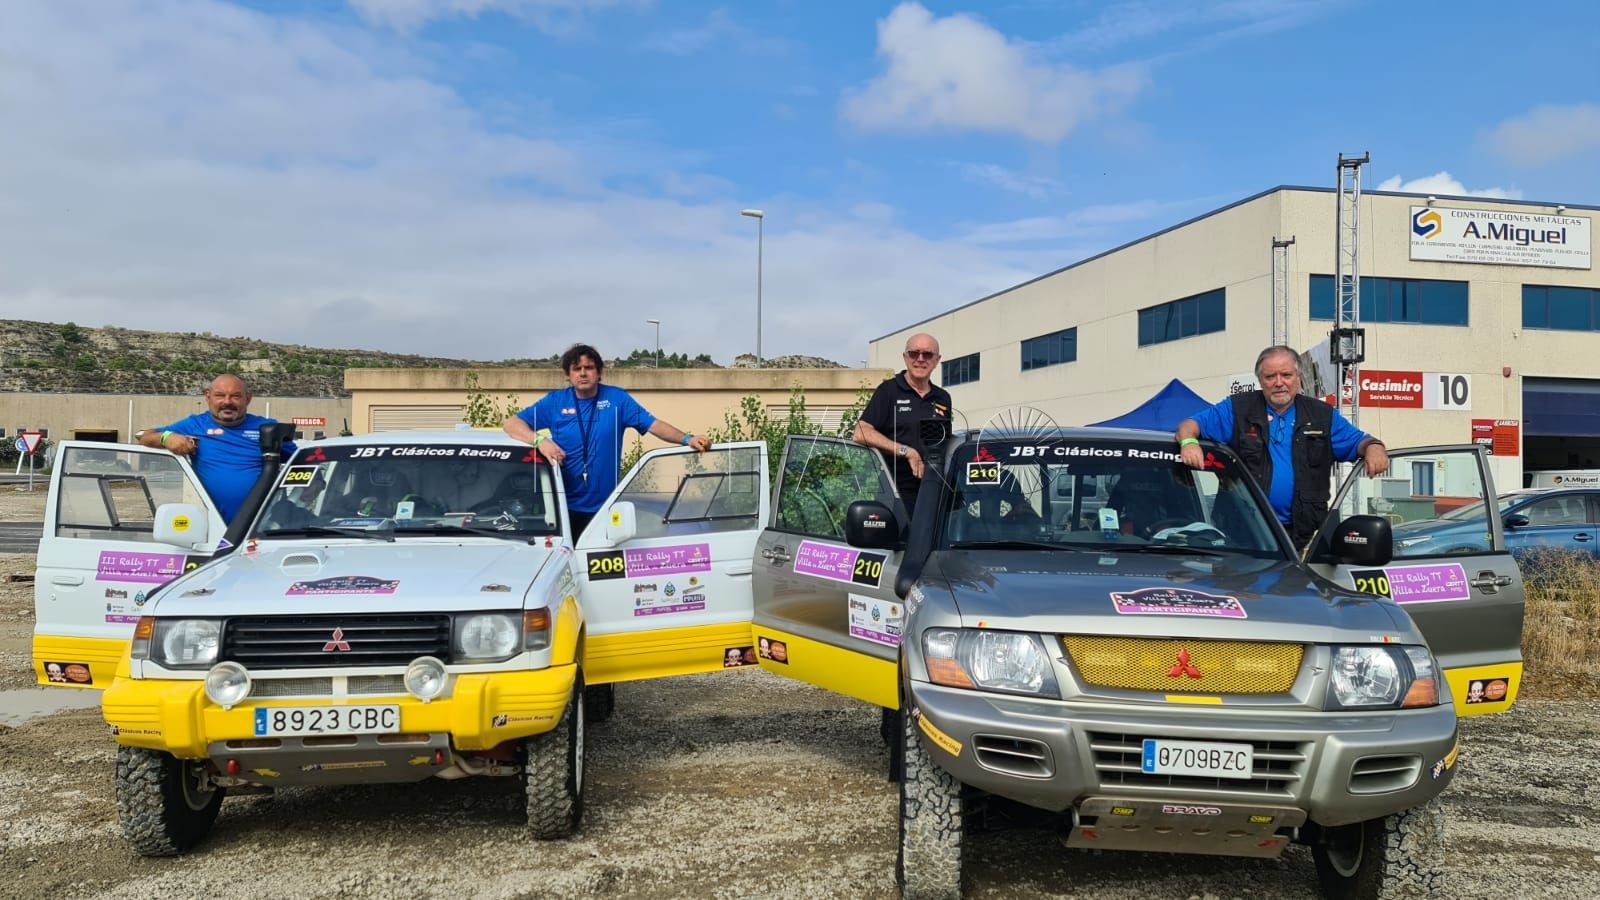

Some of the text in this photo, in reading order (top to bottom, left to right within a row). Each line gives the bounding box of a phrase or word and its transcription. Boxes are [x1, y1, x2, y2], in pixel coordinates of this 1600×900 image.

[1451, 211, 1531, 222] CONSTRUCCIONES
[1463, 221, 1566, 246] A.Miguel
[1361, 379, 1422, 392] Casimiro
[1440, 375, 1469, 406] 10
[350, 446, 511, 460] JBT Clásicos Racing
[1010, 446, 1184, 461] JBT Clásicos Racing
[286, 471, 311, 481] 208
[970, 469, 997, 478] 210
[646, 552, 671, 564] Rally
[673, 550, 686, 559] TT
[812, 549, 828, 563] Rally
[830, 552, 840, 560] TT
[120, 558, 143, 570] Rally
[145, 559, 160, 567] TT
[590, 557, 625, 574] 208
[797, 558, 812, 567] Villa
[818, 561, 836, 571] Zuera
[854, 558, 881, 578] 210
[1356, 577, 1389, 596] 210
[1390, 571, 1442, 588] III Rally TT
[1393, 585, 1414, 595] Villa
[1421, 584, 1446, 593] Zuera
[273, 710, 339, 732] 8923
[349, 708, 395, 730] CBC
[1158, 747, 1247, 771] 0709BZC
[1112, 807, 1135, 816] OMP
[1250, 816, 1273, 824] OMP
